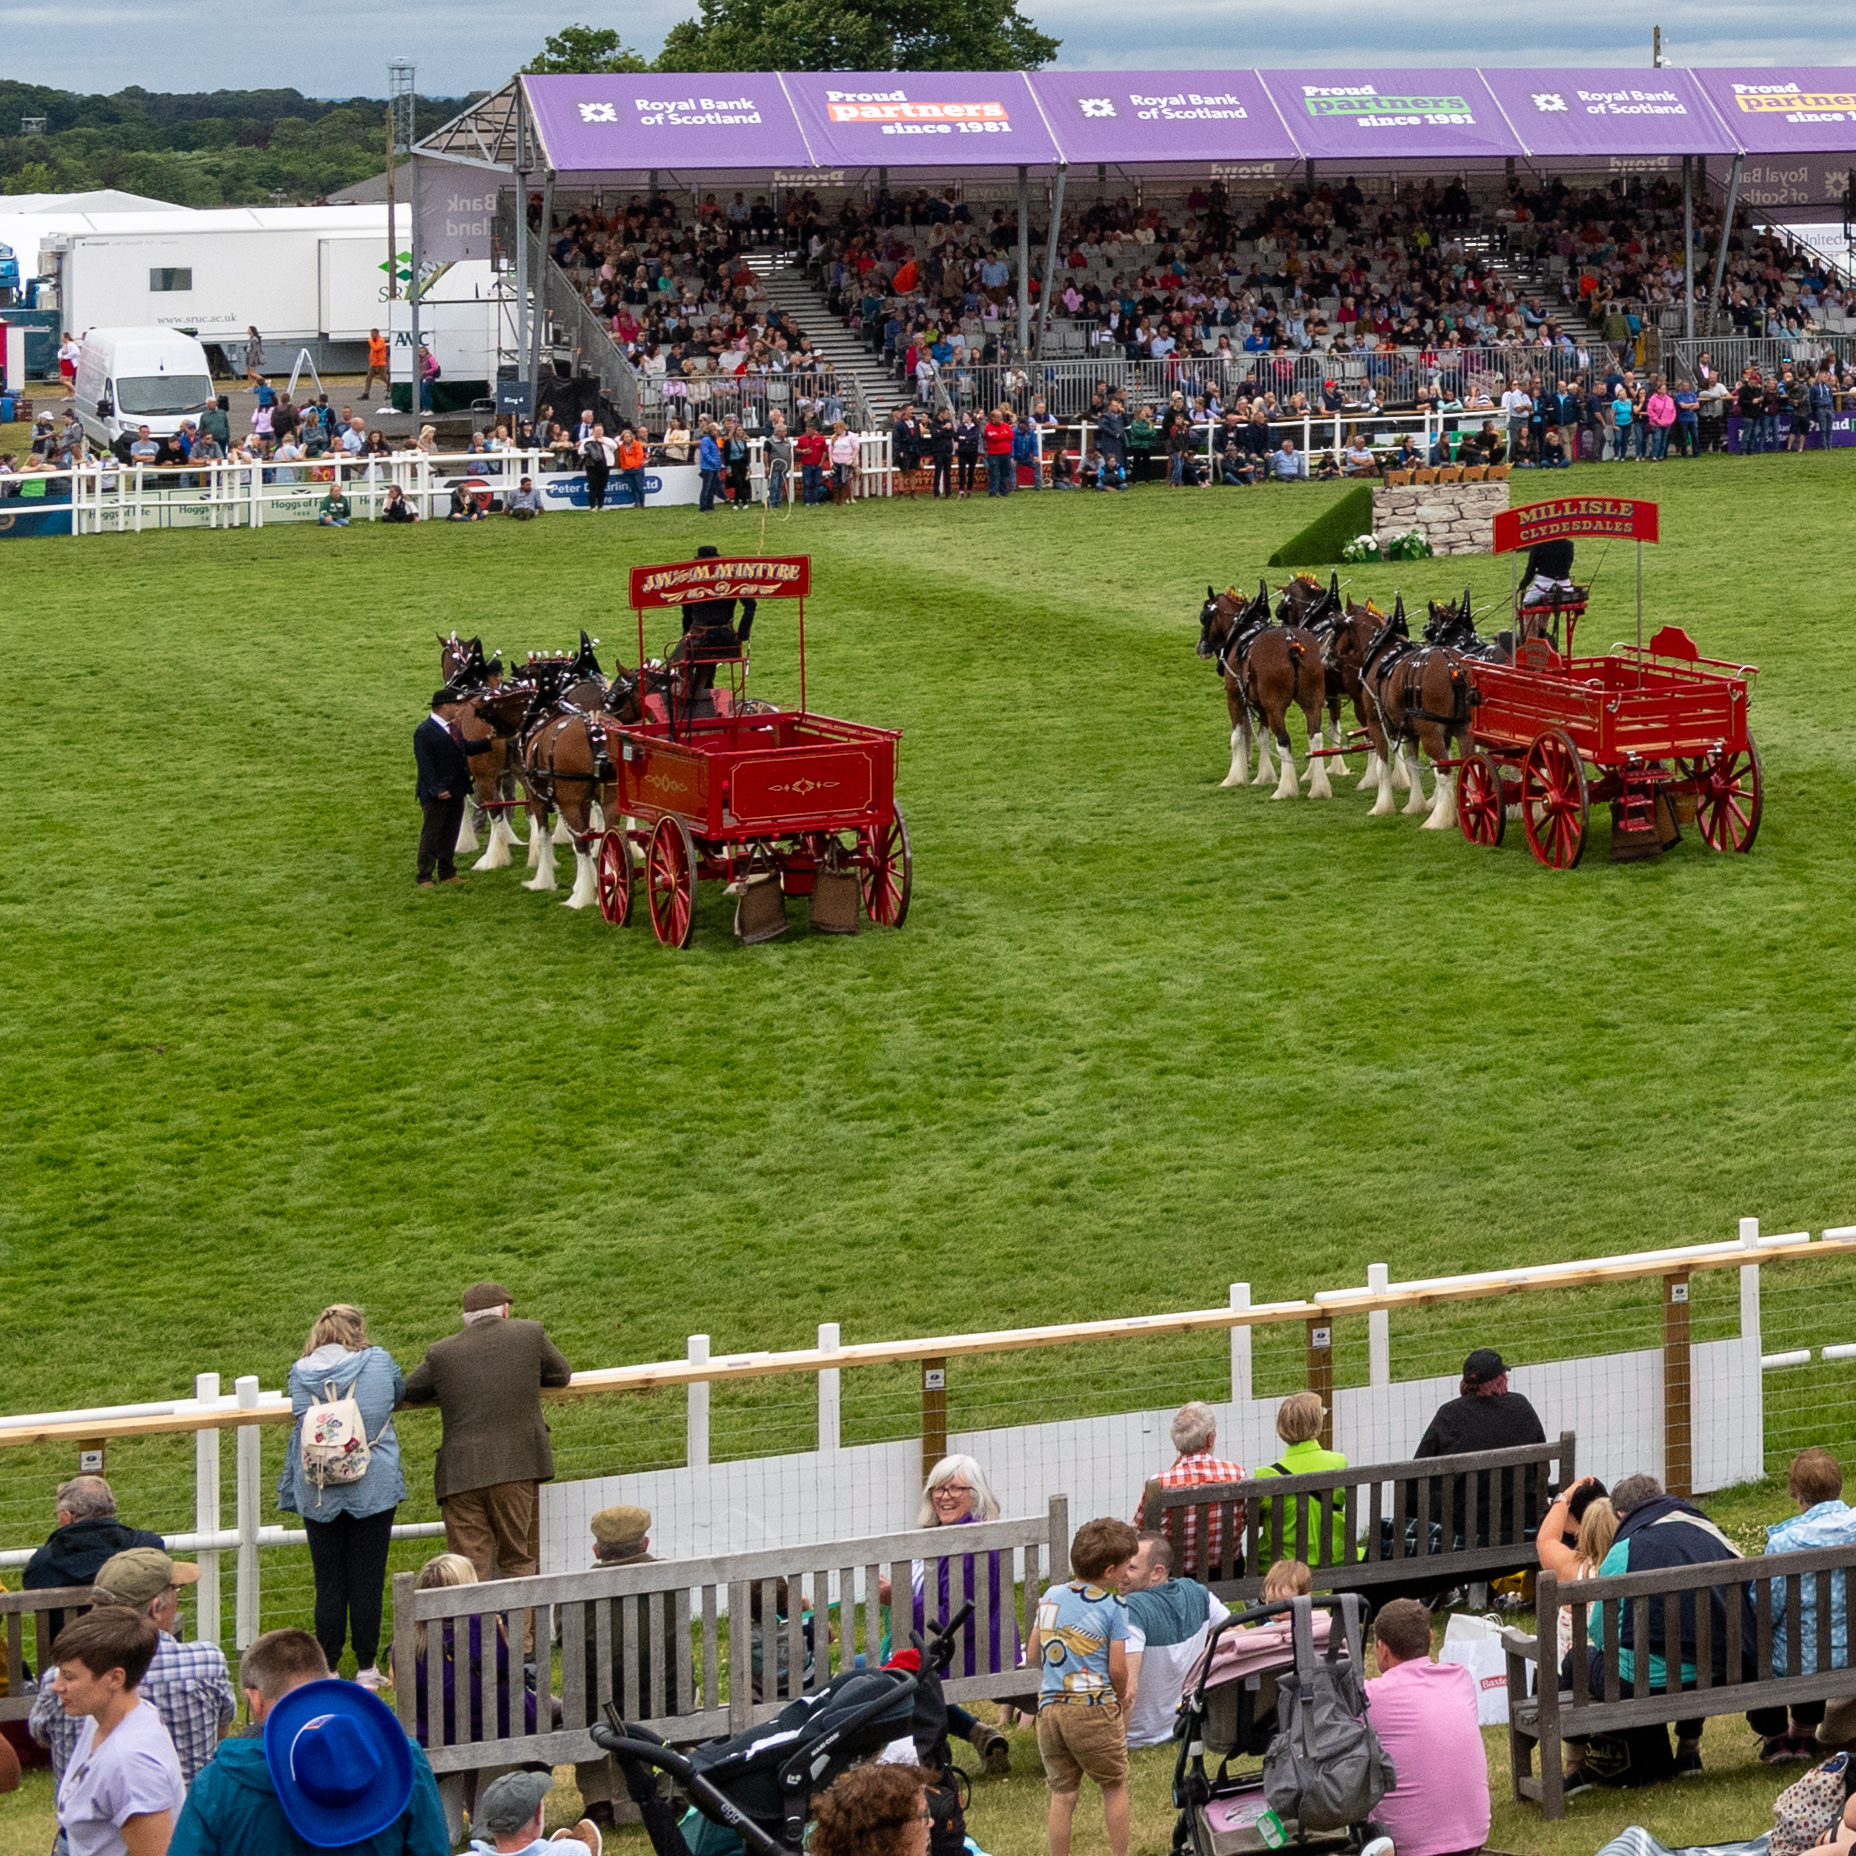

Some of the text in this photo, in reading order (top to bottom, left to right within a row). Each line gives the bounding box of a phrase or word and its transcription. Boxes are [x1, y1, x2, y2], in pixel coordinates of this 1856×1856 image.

[1302, 85, 1377, 96] Proud
[1732, 83, 1801, 93] Proud
[826, 91, 908, 102] Proud
[1130, 94, 1240, 108] Royal Bank
[1577, 90, 1679, 104] Royal Bank
[635, 98, 757, 114] Royal Bank
[832, 103, 1004, 121] partners
[1310, 97, 1464, 115] partners
[1587, 103, 1688, 115] of Scotland
[641, 112, 762, 125] of Scotland
[1137, 107, 1248, 120] of Scotland
[1357, 114, 1477, 126] since 1981
[1786, 112, 1846, 123] since
[882, 122, 1012, 134] since 1981
[1518, 500, 1635, 525] MILLISLE
[1519, 520, 1634, 541] CLYDESDALES
[1482, 1675, 1509, 1690] Baxte
[720, 1802, 742, 1825] egg
